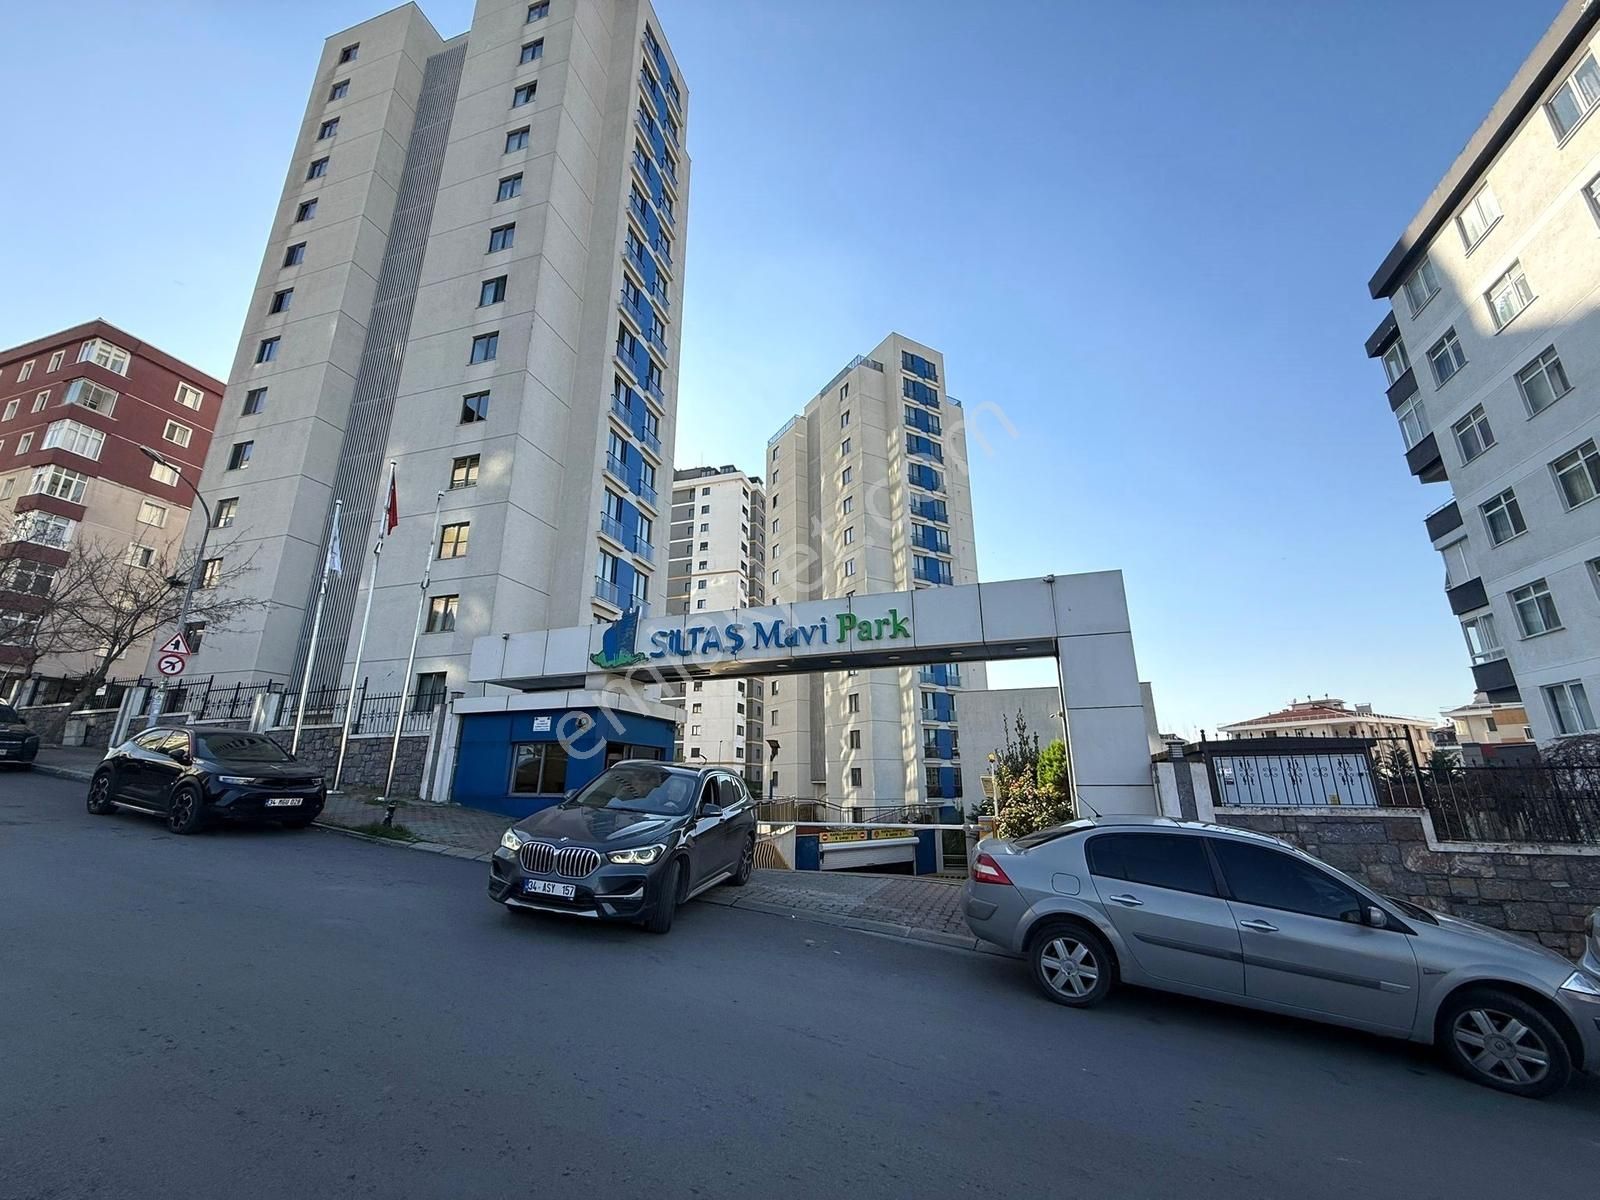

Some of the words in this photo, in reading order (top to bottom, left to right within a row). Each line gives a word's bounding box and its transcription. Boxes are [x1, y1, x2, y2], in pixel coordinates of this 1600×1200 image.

[752, 616, 829, 649] Mavi
[836, 608, 911, 643] Park
[528, 881, 537, 891] 34
[542, 882, 555, 893] ASY
[562, 885, 575, 896] 157
